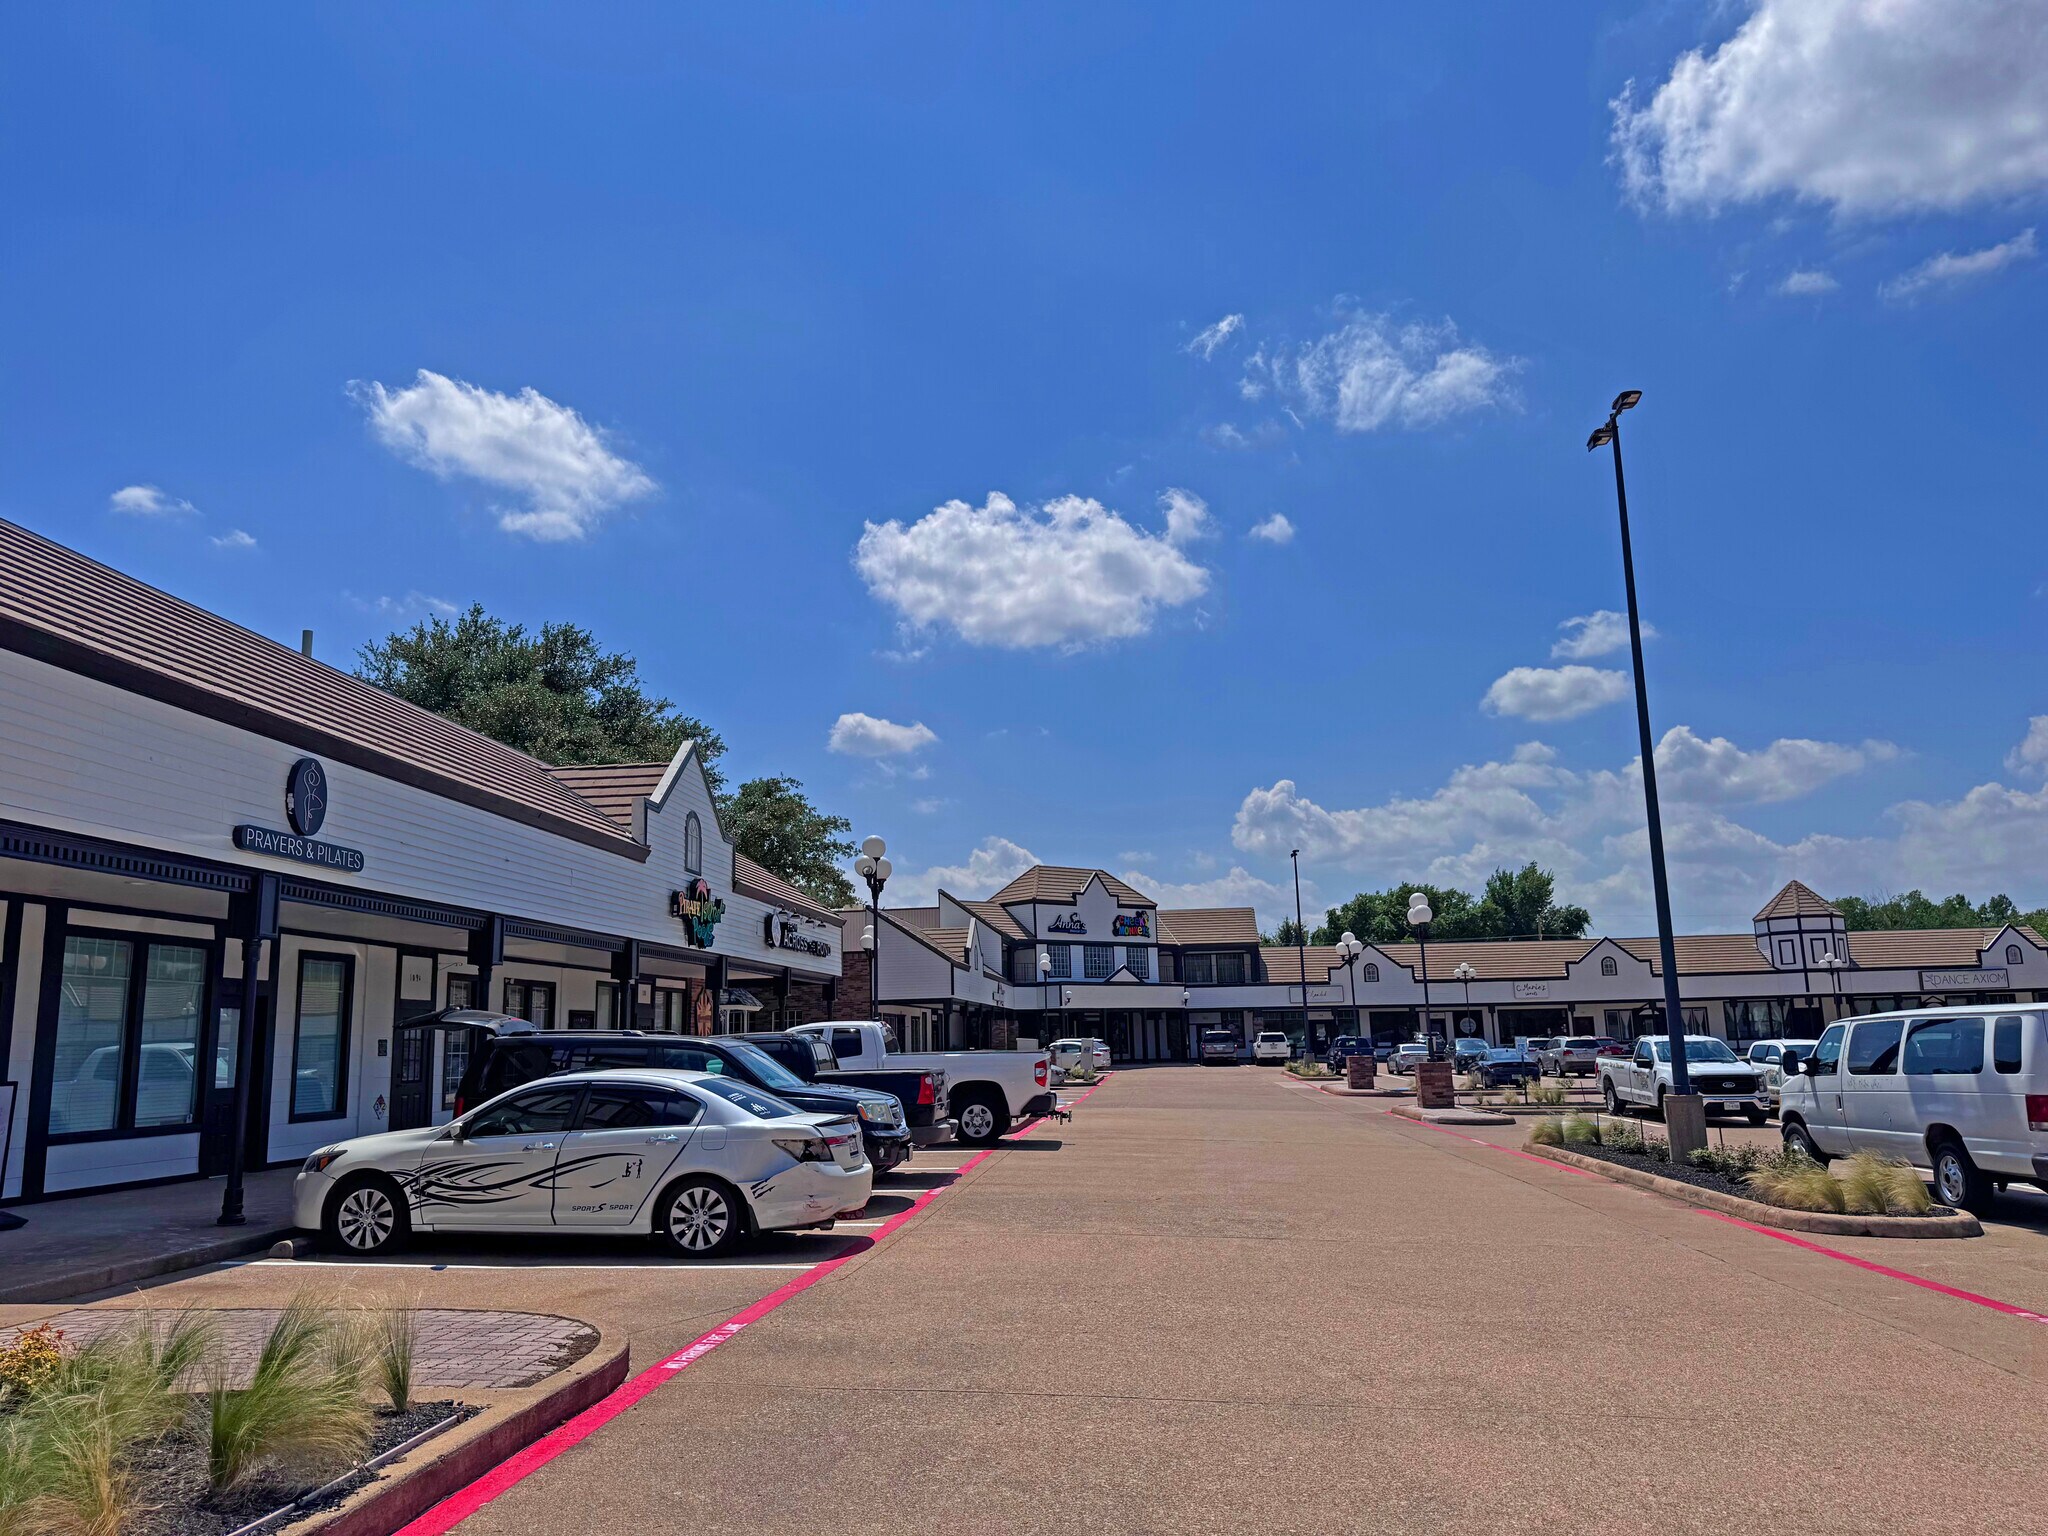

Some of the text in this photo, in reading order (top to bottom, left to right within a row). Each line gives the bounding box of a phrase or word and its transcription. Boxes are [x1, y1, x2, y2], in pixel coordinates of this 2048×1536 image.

[246, 828, 361, 869] PRAYERS & PILATES
[784, 930, 808, 951] ACROSS
[1934, 973, 2007, 985] DANCE AXIOM
[660, 1322, 749, 1370] NO PARKING FIRE LANE
